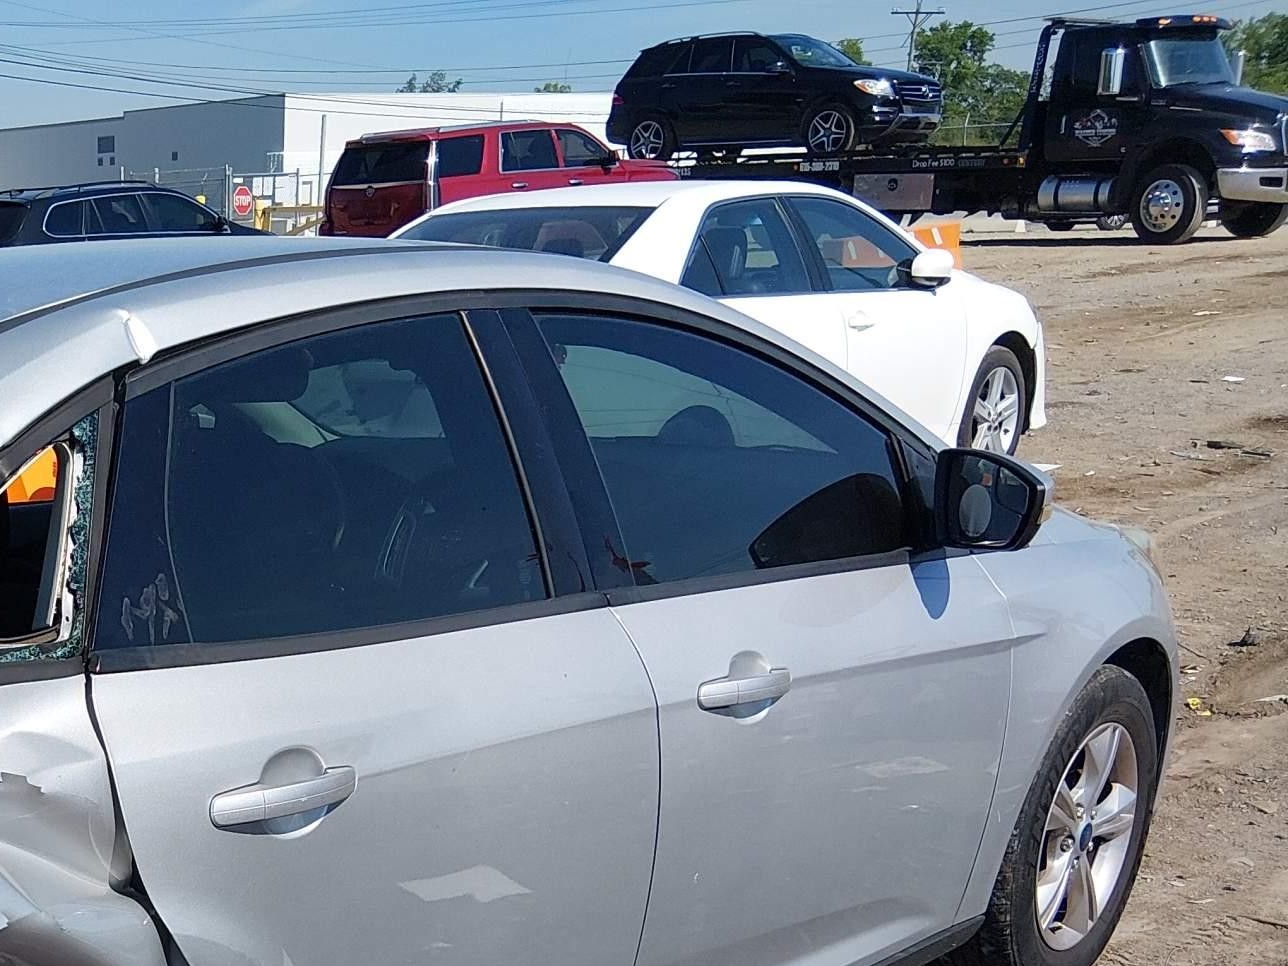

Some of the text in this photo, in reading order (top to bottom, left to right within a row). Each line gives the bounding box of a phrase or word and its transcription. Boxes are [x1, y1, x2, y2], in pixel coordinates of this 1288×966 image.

[912, 158, 955, 168] Drop Fee $100
[235, 195, 251, 206] STOP
